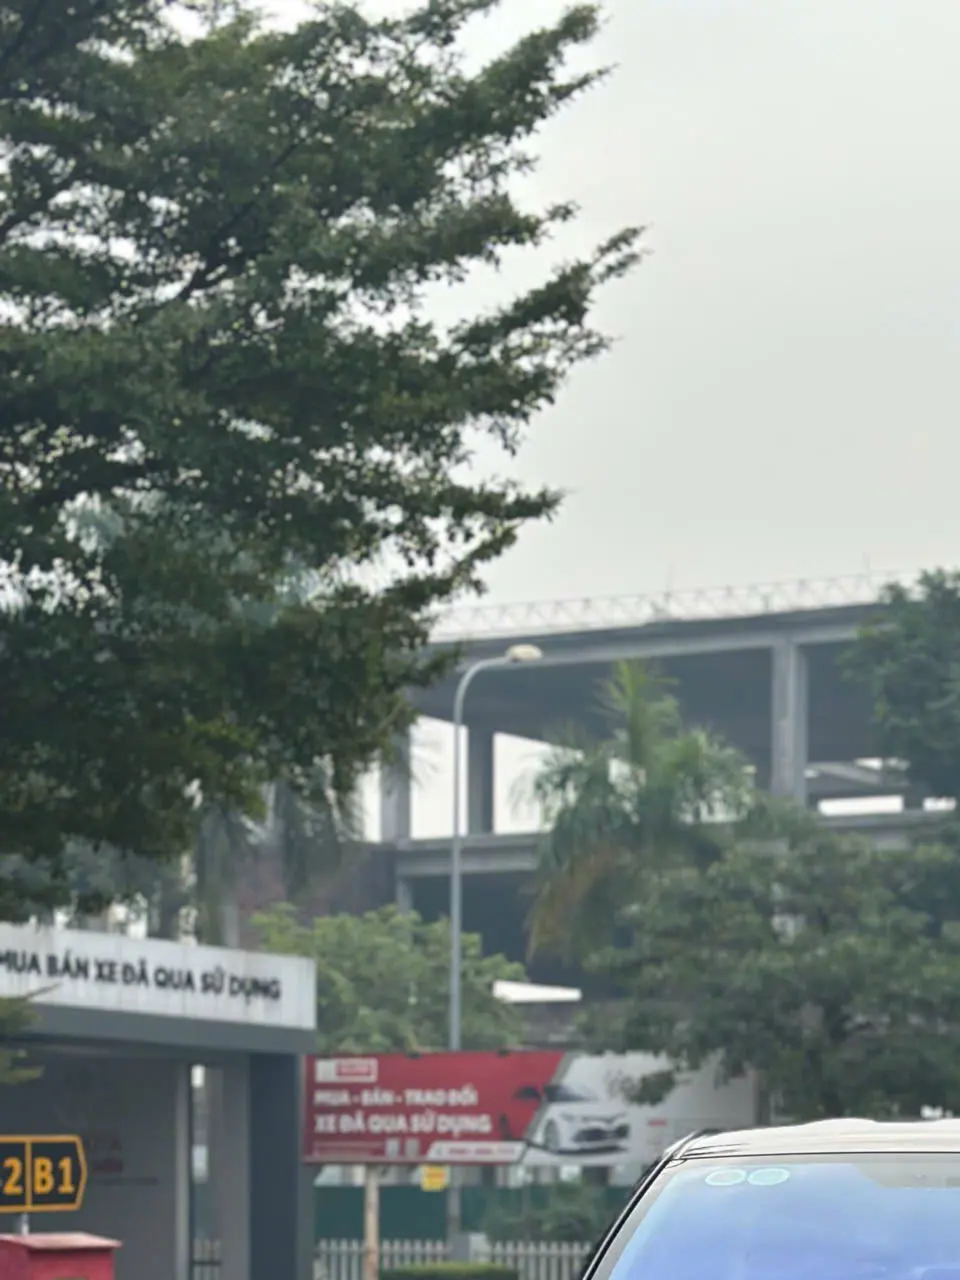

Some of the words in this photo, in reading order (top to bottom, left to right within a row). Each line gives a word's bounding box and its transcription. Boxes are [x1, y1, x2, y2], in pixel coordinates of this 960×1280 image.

[46, 949, 90, 980] BÁN
[93, 958, 118, 984] XE
[121, 956, 150, 988] ĐÃ
[153, 966, 196, 993] QUA
[228, 973, 281, 1006] DỤNG
[314, 1113, 337, 1134] XE
[366, 1113, 409, 1134] QUA
[436, 1113, 492, 1139] DỤNG
[0, 1156, 23, 1195] 2
[33, 1156, 75, 1195] B1
